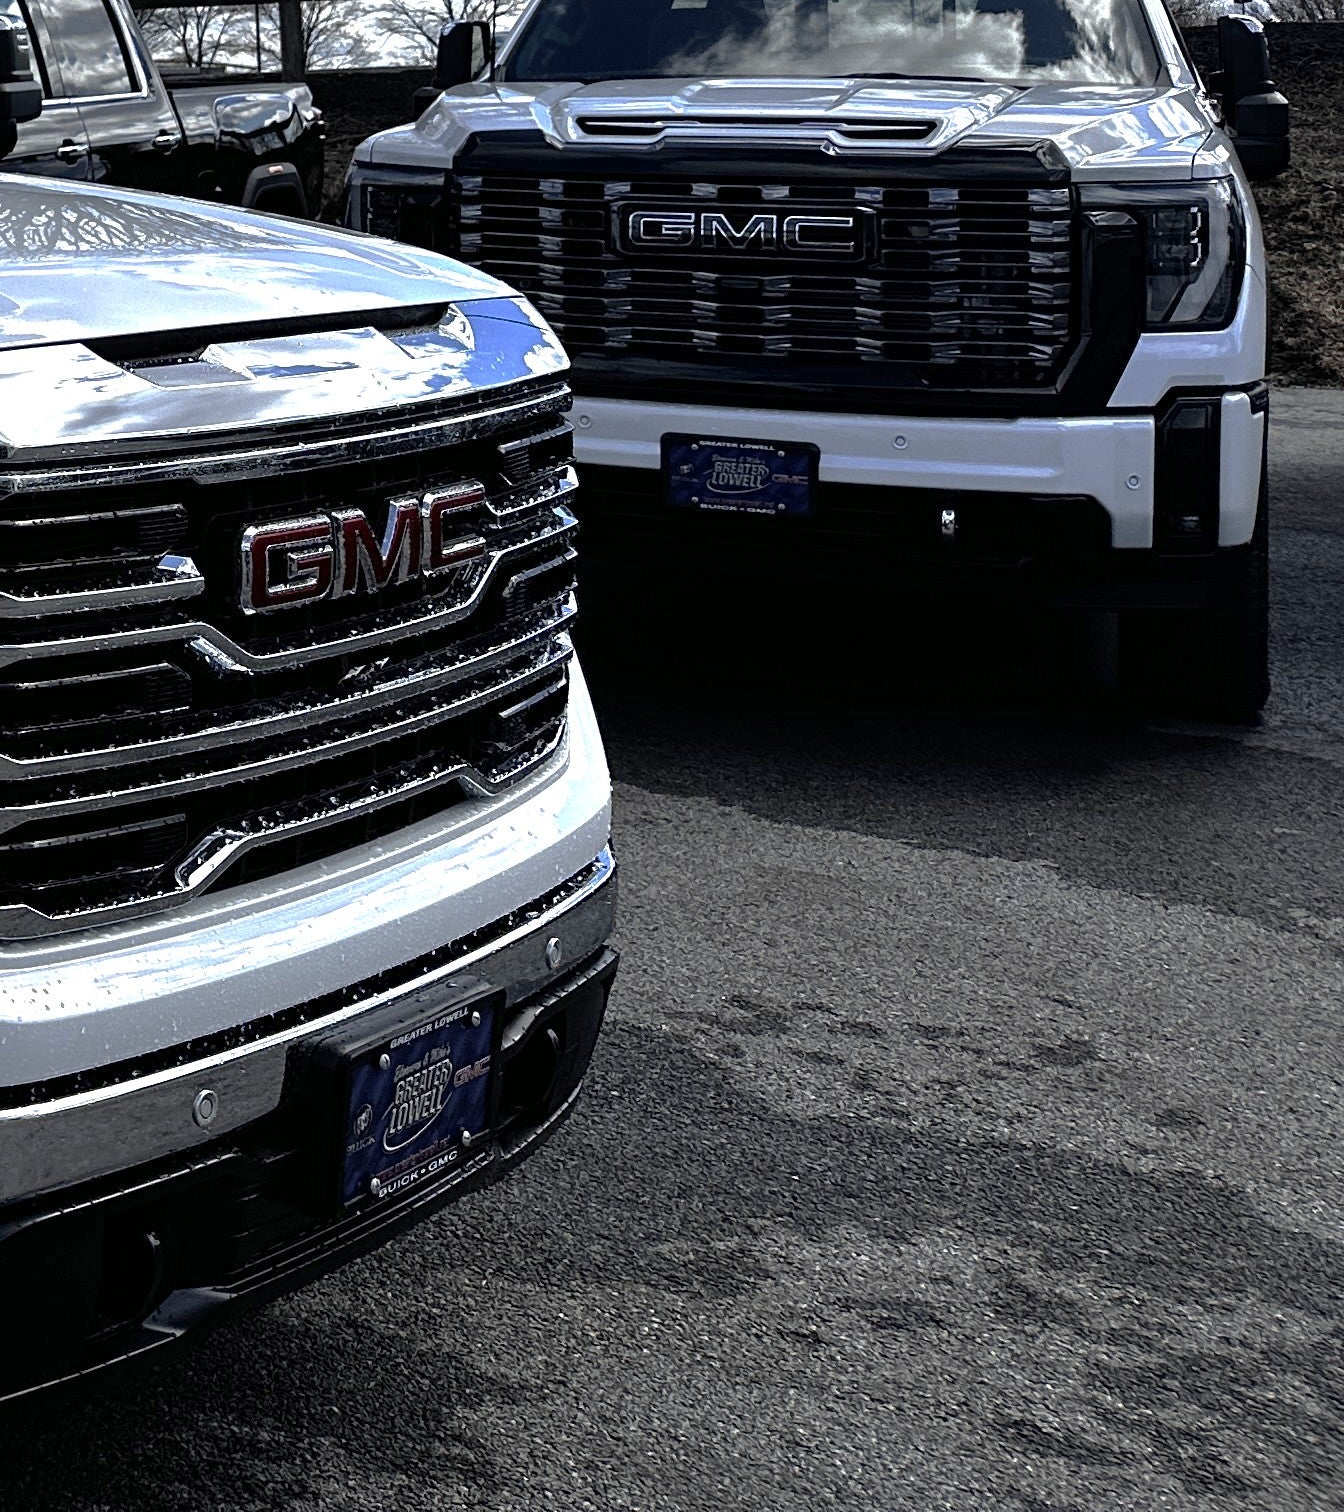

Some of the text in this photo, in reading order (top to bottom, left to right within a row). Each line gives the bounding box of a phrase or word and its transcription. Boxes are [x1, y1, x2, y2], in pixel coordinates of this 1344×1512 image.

[628, 211, 855, 253] GMC
[711, 472, 763, 488] LOWELL
[713, 461, 766, 475] GREATER
[240, 478, 487, 616] GMC
[390, 1006, 469, 1049] GREATER LOWELL
[394, 1058, 452, 1106] GREATER
[453, 1054, 491, 1088] GMC
[387, 1085, 444, 1135] LOWELL
[378, 1169, 419, 1198] BUICK
[428, 1150, 458, 1172] GMC
